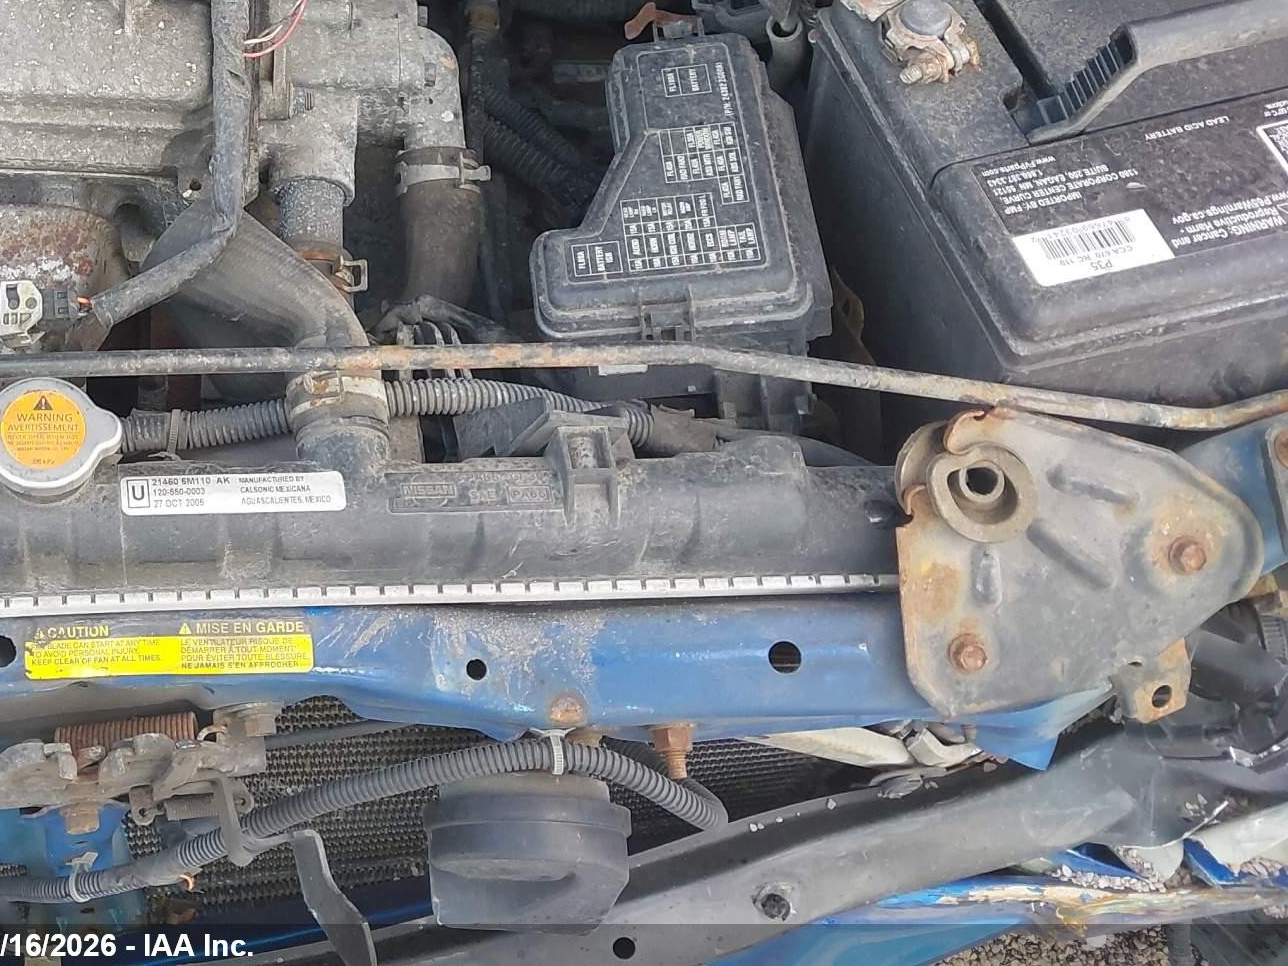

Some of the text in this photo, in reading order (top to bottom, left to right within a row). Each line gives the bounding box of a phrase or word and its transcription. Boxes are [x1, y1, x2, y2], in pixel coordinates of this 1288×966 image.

[1144, 115, 1230, 140] LEAD ACID BATTERY
[981, 155, 1057, 177] www.FVPparts.com
[1082, 164, 1109, 175] SUITE
[1018, 181, 1033, 190] MN
[1032, 173, 1065, 187] EAGAN,
[1066, 170, 1118, 190] CORPORATE
[1032, 184, 1067, 197] CENTER
[1004, 191, 1082, 215] IMPORTED BY: FMP
[1213, 206, 1279, 227] Reproductive
[1171, 215, 1287, 249] WARNING: Cancer and
[1185, 220, 1214, 234] Harm
[738, 230, 747, 243] TAIL
[746, 227, 755, 244] LAMP
[1111, 245, 1133, 255] CCA
[594, 246, 606, 271] BATTERY
[1090, 259, 1113, 271] P35
[16, 413, 73, 422] WARNING
[7, 423, 79, 432] AVERTISSEMENT
[152, 478, 179, 486] 21460
[239, 475, 294, 484] MANUFACTURED
[132, 485, 145, 501] U
[275, 485, 311, 493] MEXICANA
[404, 486, 454, 496] NISSAN
[154, 498, 205, 508] 27 OCT 2005
[305, 495, 332, 503] MEXICO
[47, 625, 109, 639] CAUTION
[196, 621, 305, 634] MISE EN GARDE
[73, 641, 89, 649] CAN
[90, 640, 114, 648] START
[124, 639, 140, 647] ANY
[180, 638, 190, 646] LE
[192, 638, 248, 646] VENTILATEUR
[249, 637, 280, 645] RISQUE
[44, 650, 66, 658] AVOID
[68, 649, 110, 657] PERSONAL
[181, 654, 204, 662] POUR
[206, 653, 235, 661] ÉVITER
[237, 653, 264, 661] TOUTE
[194, 661, 225, 669] JAMAIS
[227, 661, 246, 669] S'EN
